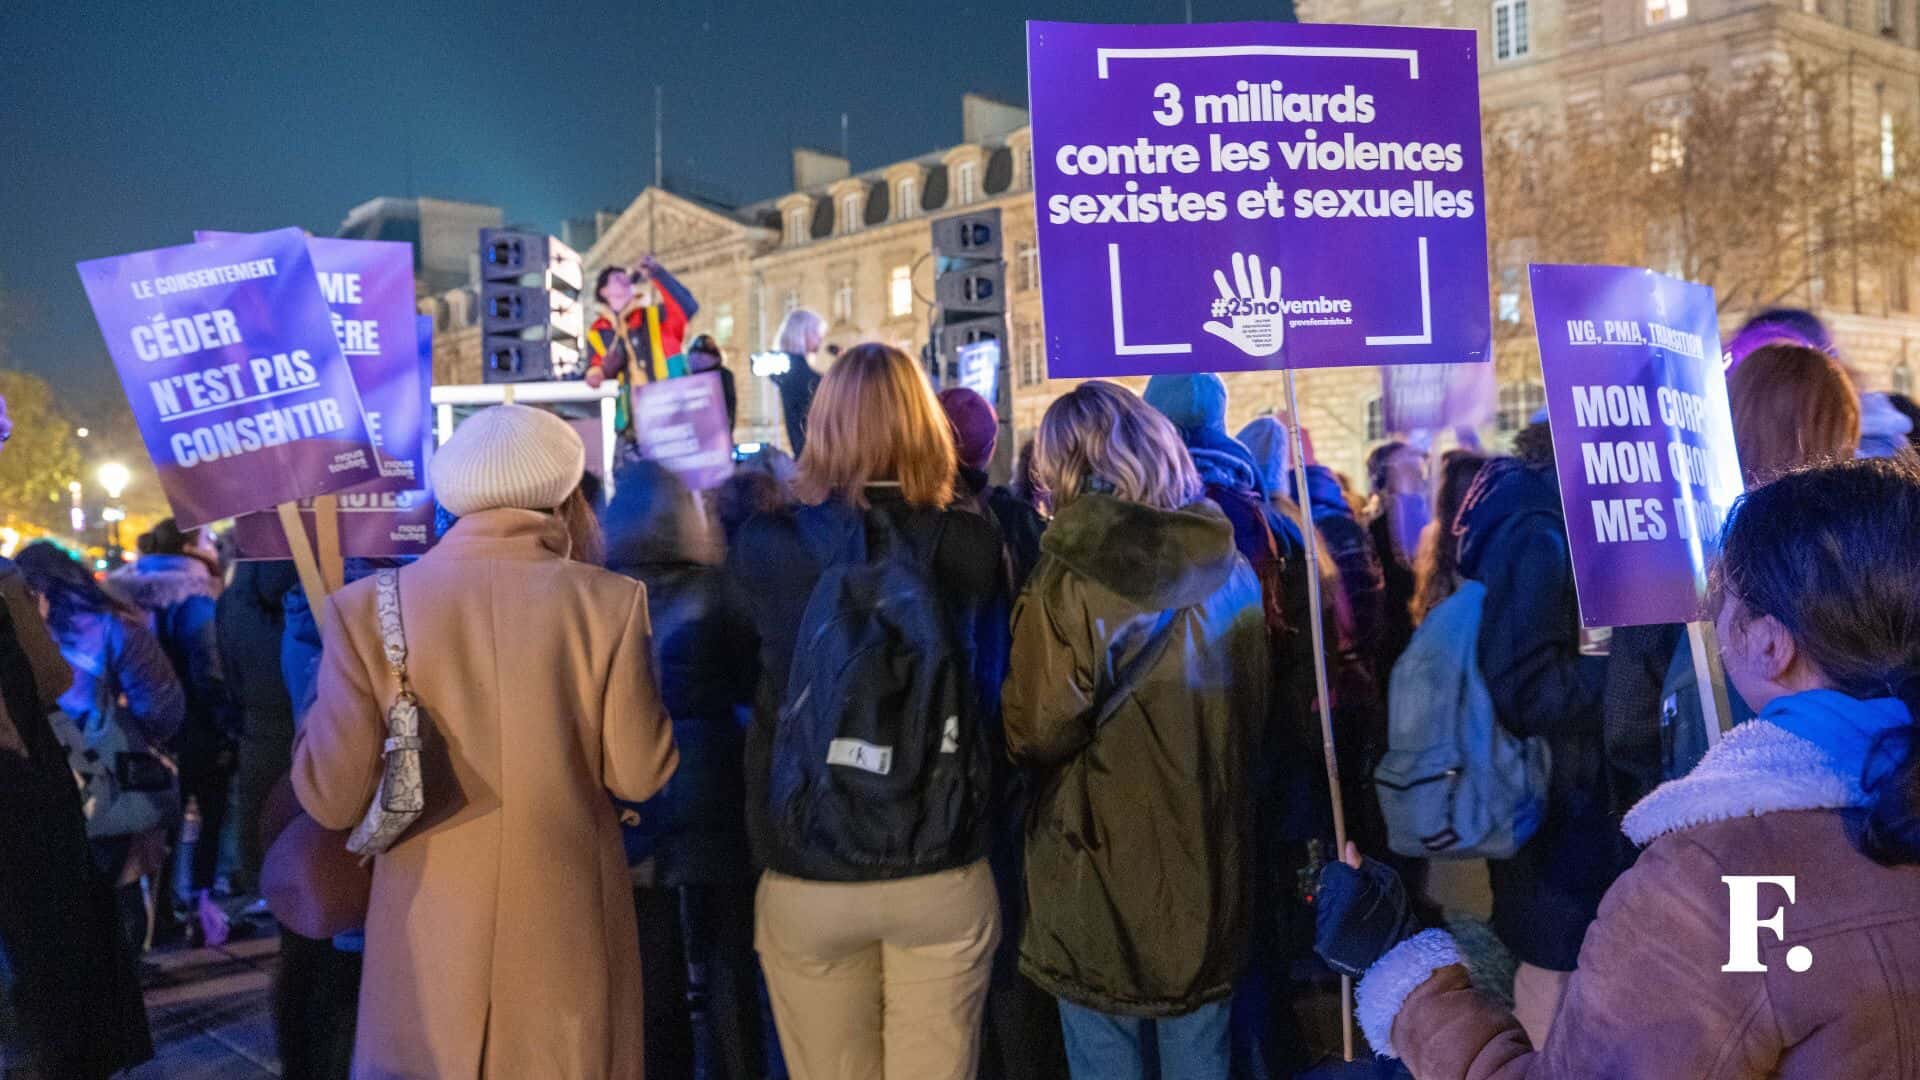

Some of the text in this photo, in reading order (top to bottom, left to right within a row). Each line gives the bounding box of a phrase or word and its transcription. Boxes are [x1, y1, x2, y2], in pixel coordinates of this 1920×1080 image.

[1153, 80, 1375, 126] 3 milliards
[1056, 128, 1463, 176] contre les violences
[1048, 177, 1474, 224] sexistes et sexuelles
[131, 258, 277, 299] LE CONSENTEMENT
[1210, 296, 1352, 317] #25novembre
[130, 309, 242, 362] CÉDER
[1567, 320, 1602, 343] IVG,
[1604, 320, 1647, 343] PMA,
[250, 349, 317, 394] PAS
[1572, 385, 1707, 432] MON CORP
[170, 398, 344, 469] CONSENTIR
[1581, 441, 1662, 485] MON
[1591, 498, 1667, 543] MES
